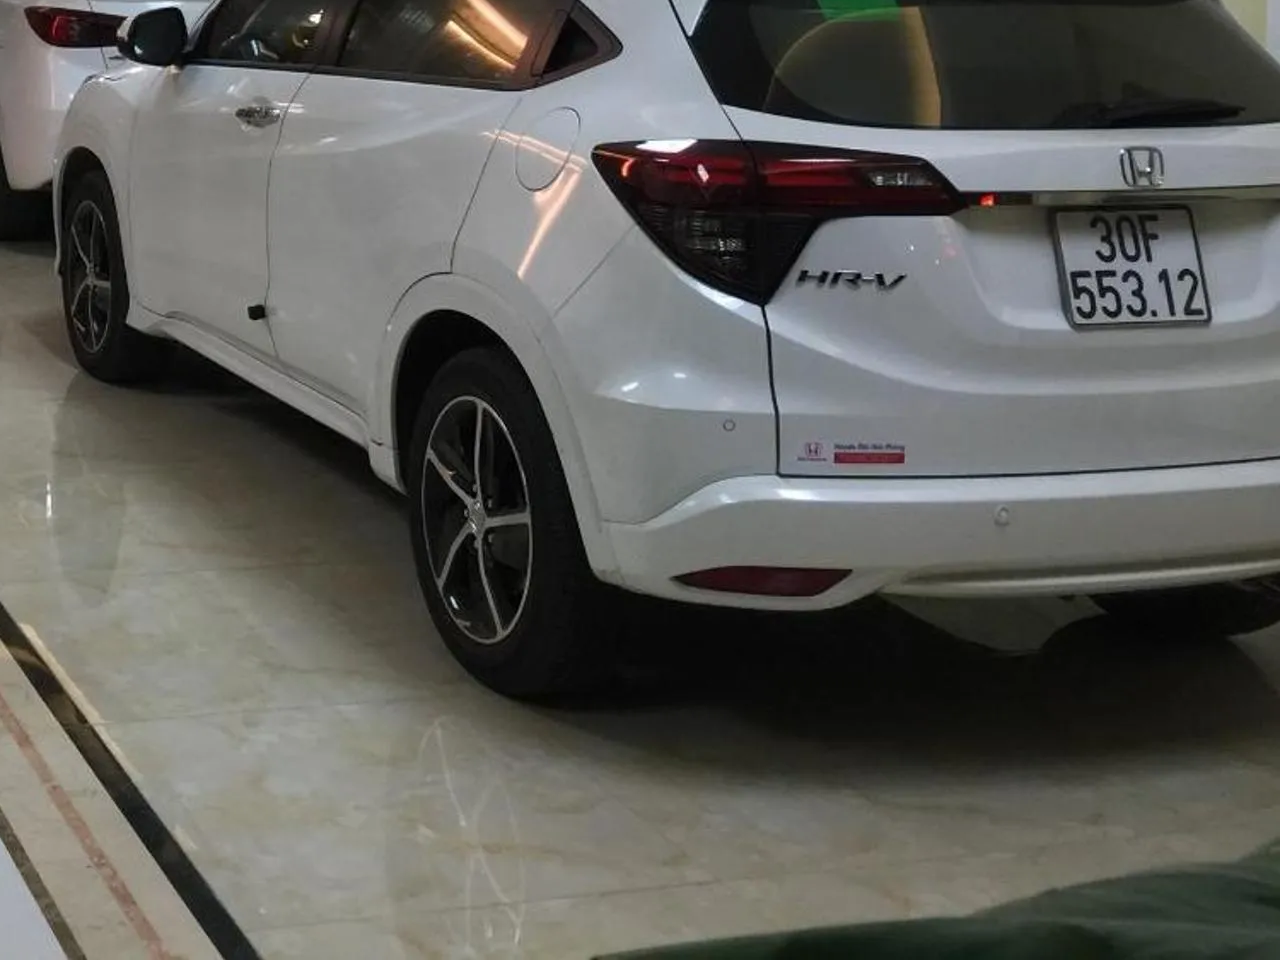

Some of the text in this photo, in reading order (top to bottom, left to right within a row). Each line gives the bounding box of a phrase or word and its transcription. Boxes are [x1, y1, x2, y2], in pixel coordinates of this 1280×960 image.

[1089, 213, 1160, 263] 30F
[796, 269, 908, 291] HR-V
[1070, 268, 1205, 320] 553.12
